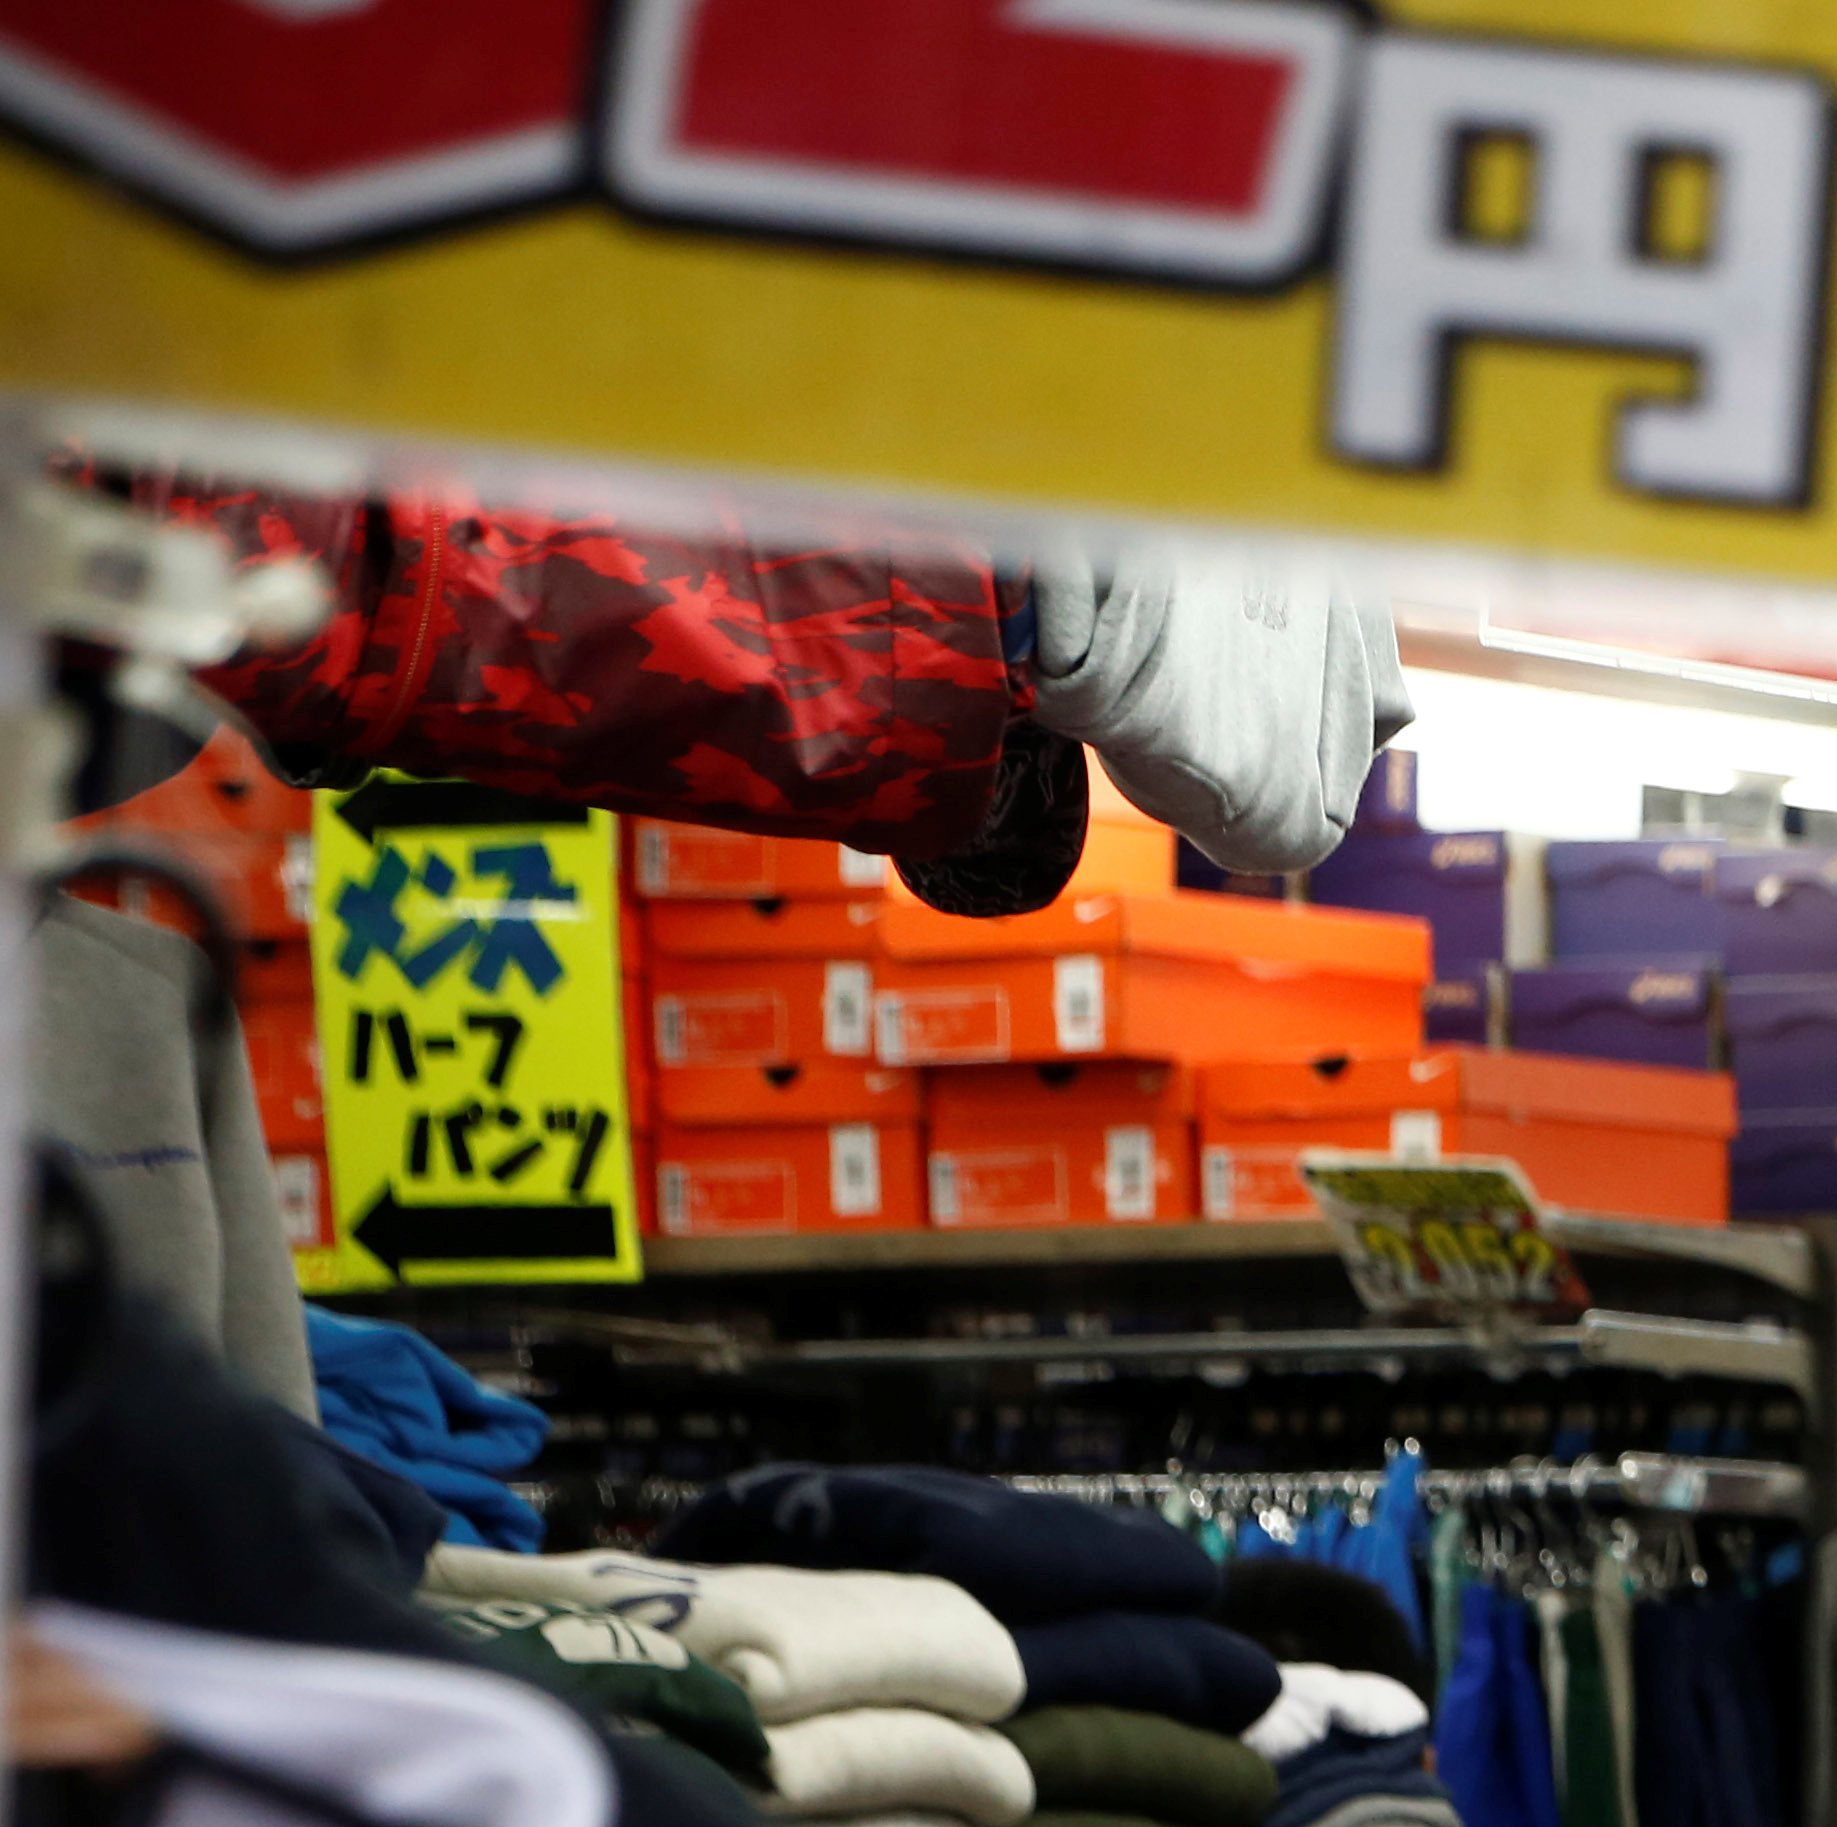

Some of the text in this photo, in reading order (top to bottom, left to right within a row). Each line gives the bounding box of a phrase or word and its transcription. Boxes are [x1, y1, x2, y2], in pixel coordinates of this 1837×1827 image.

[347, 1008, 526, 1090] ハーフ
[406, 1102, 610, 1200] パンツ
